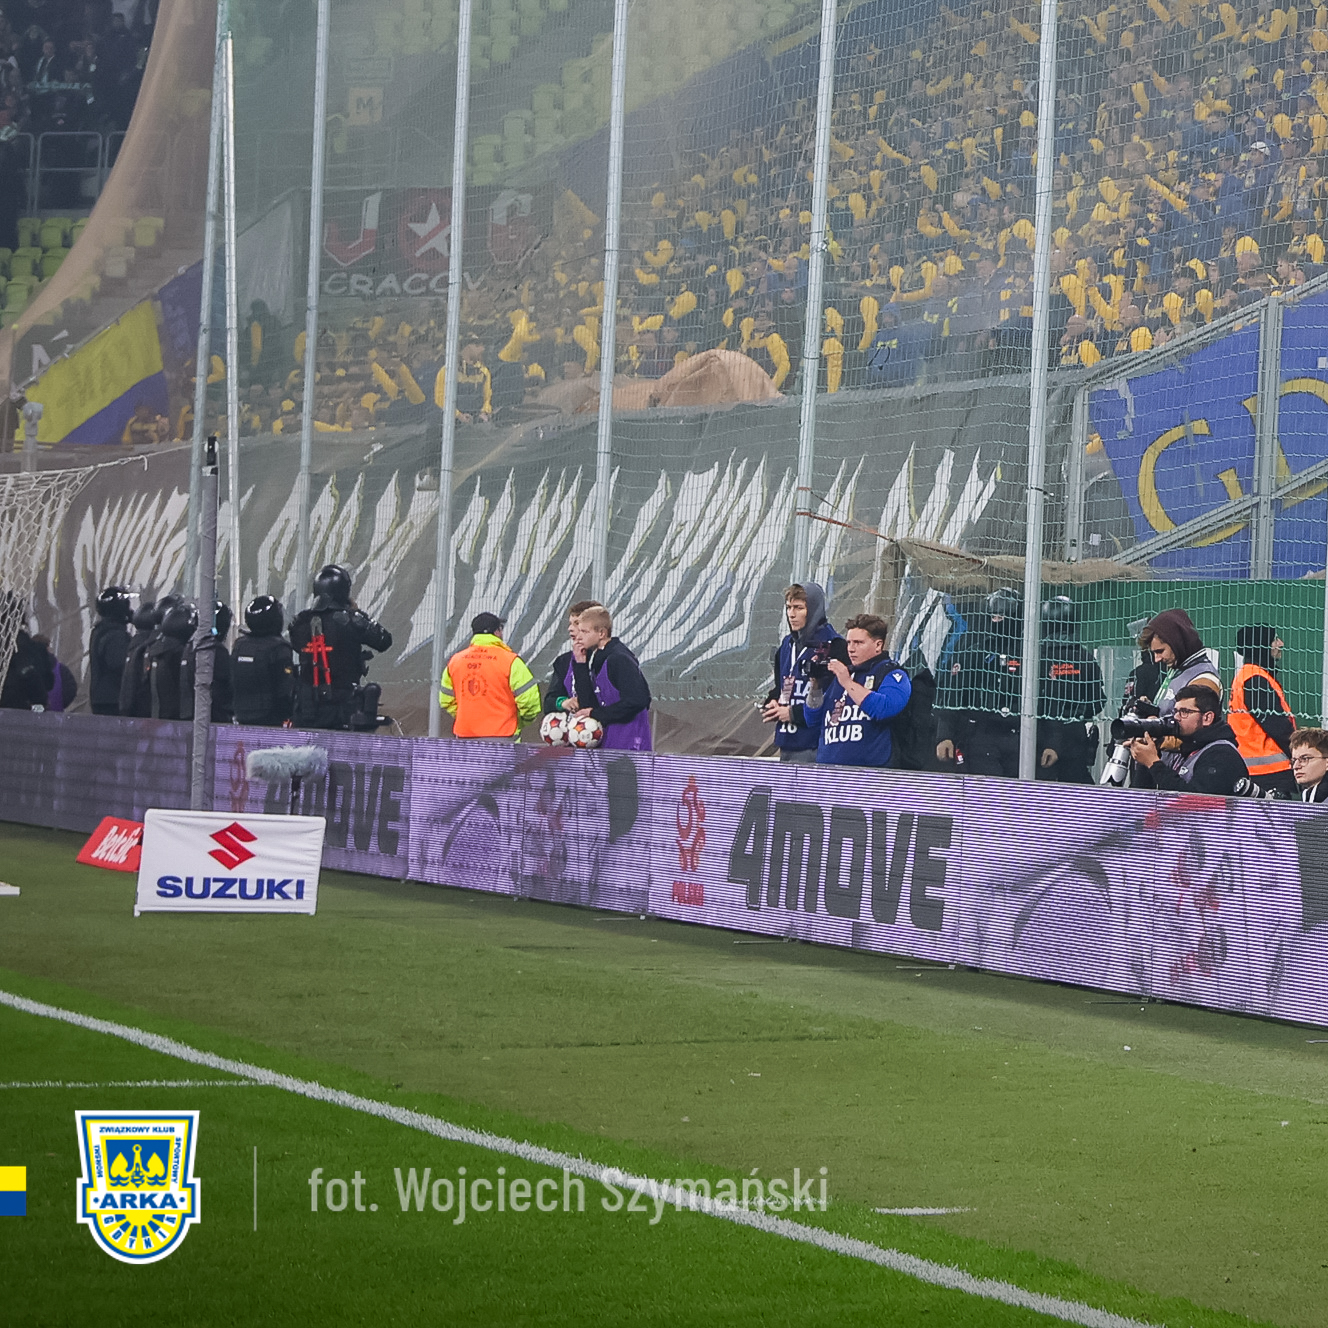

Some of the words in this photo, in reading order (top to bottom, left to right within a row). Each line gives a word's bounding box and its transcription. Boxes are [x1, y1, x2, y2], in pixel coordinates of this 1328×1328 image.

[824, 706, 870, 726] MDIA
[824, 724, 863, 745] KLUB
[91, 825, 141, 864] Betclic
[728, 784, 953, 932] 4MOVE
[156, 875, 305, 900] SUZUKI
